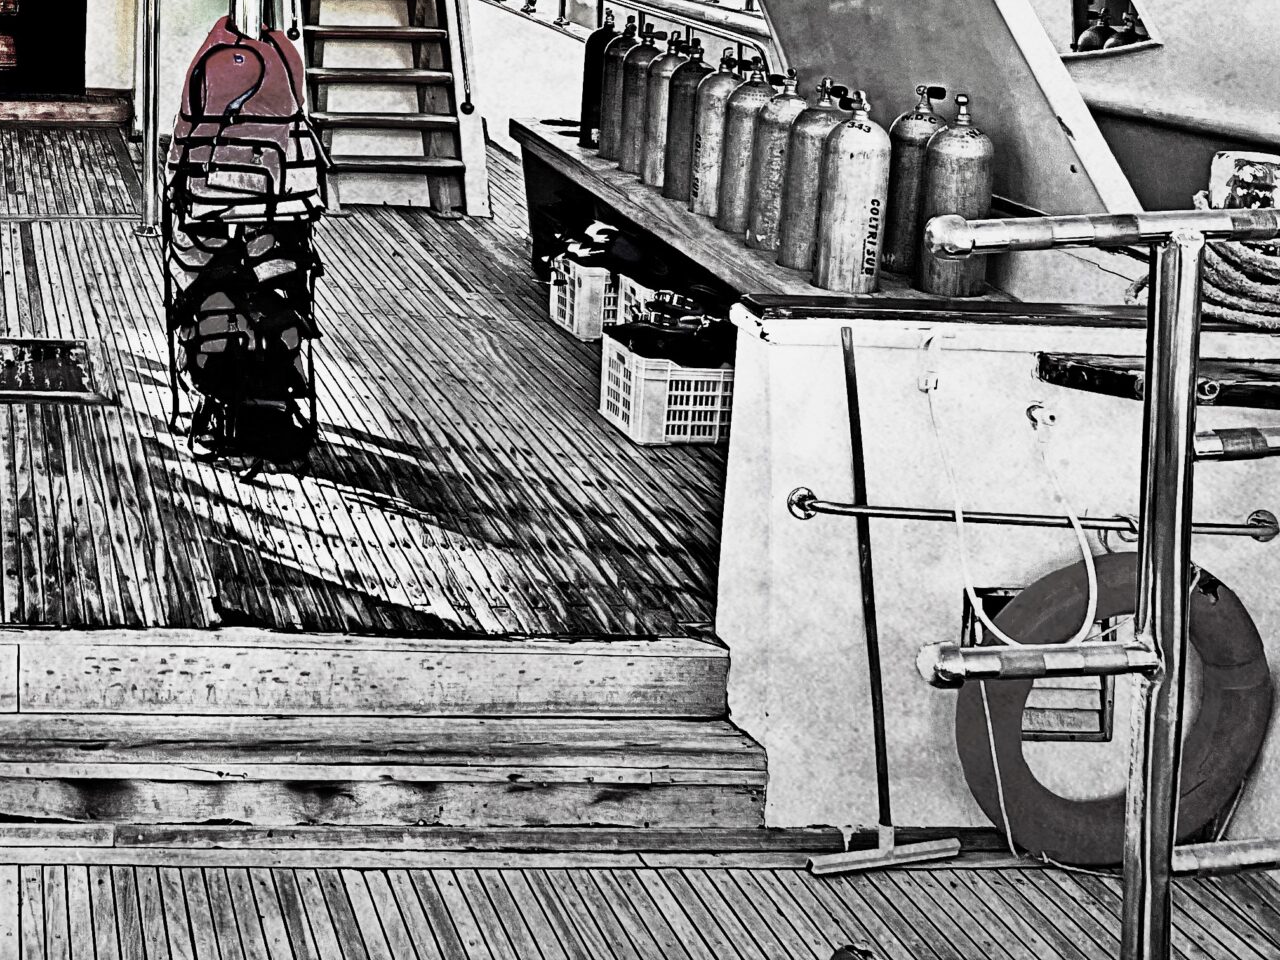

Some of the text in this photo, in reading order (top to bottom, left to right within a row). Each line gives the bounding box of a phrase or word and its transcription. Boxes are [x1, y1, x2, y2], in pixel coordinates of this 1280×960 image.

[846, 121, 872, 134] 343
[864, 198, 881, 276] COLTRI SUB
